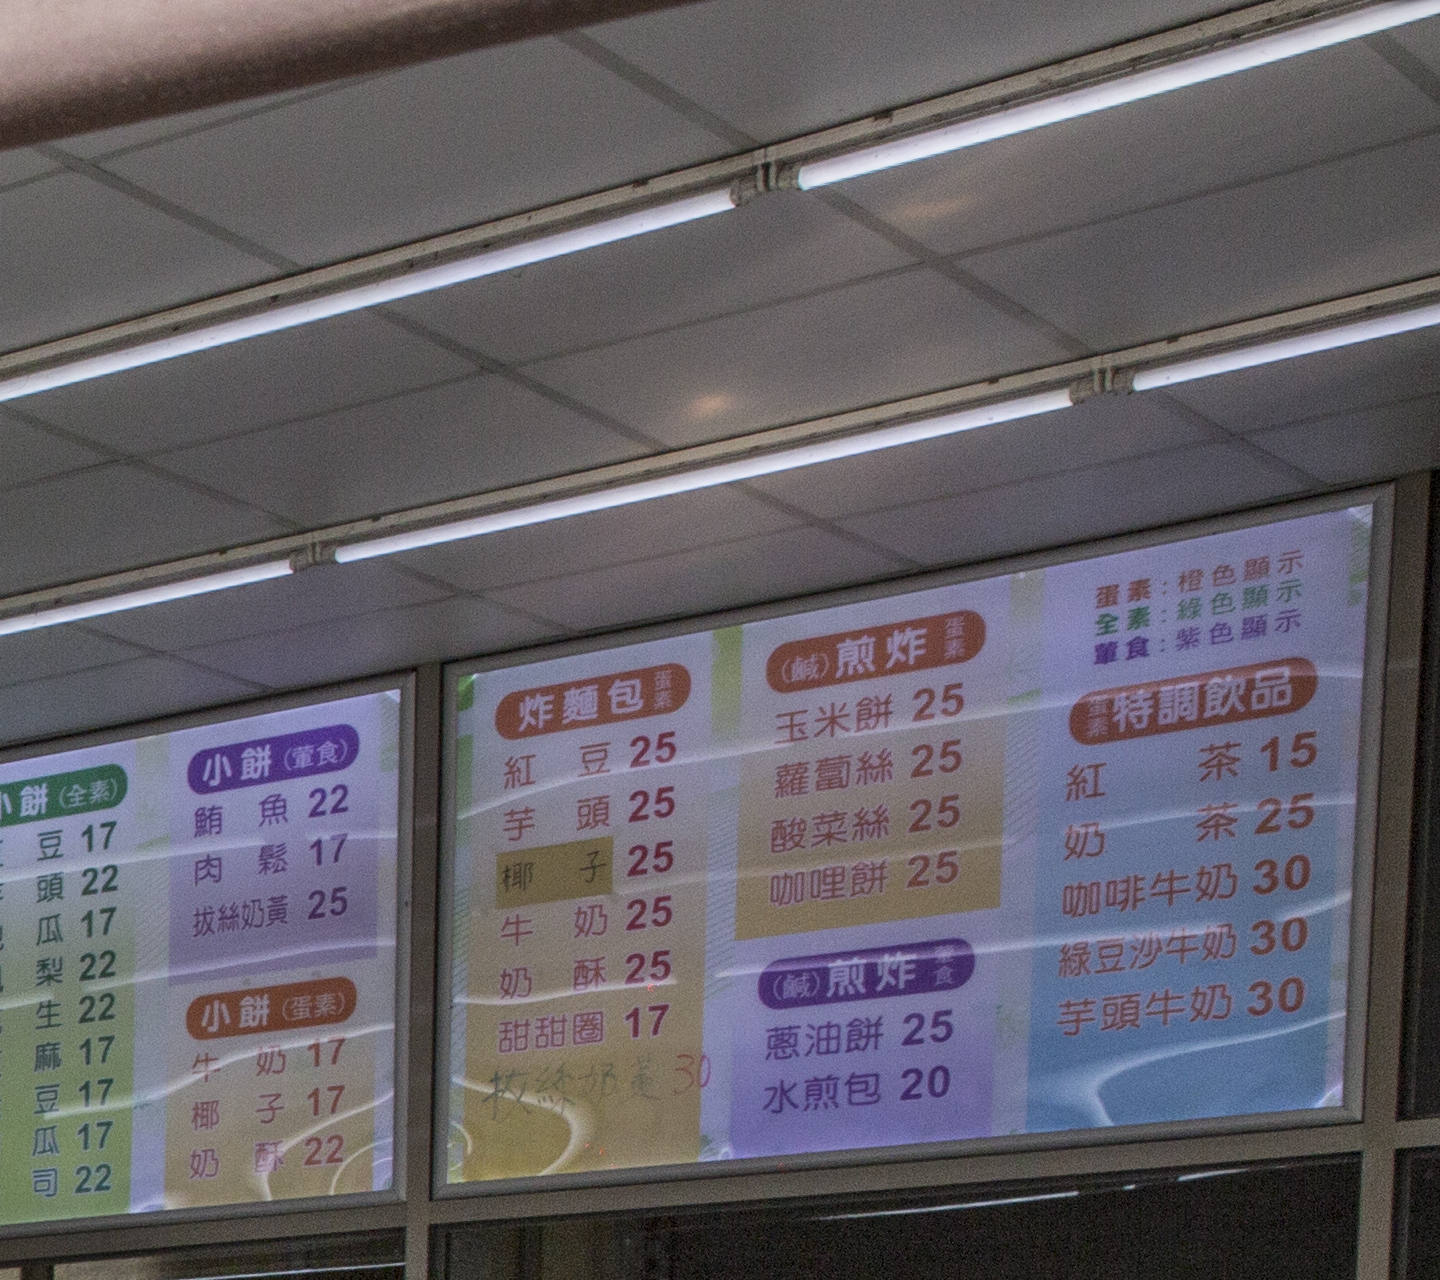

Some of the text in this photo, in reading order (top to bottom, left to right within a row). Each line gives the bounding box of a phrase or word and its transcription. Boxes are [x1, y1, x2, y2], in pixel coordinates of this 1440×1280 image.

[518, 674, 645, 732] 炸麵包
[775, 683, 964, 747] 玉米餅 25
[1114, 664, 1291, 732] 特調飲品
[504, 732, 678, 788] 紅豆 25
[773, 740, 961, 799] 蘿蔔絲 25
[1065, 730, 1318, 802] 紅茶 15
[194, 785, 349, 837] 鮪魚 22
[504, 786, 676, 841] 芋頭 25
[768, 796, 960, 855] 酸菜絲 25
[1064, 792, 1315, 860] 奶茶 25
[80, 822, 115, 852] 17
[194, 834, 345, 885] 肉鬆 17
[626, 842, 675, 880] 25
[80, 865, 119, 896] 22
[769, 851, 959, 907] 咖哩餅 25
[1062, 853, 1311, 918] 咖啡牛奶 30
[80, 908, 115, 938] 17
[192, 887, 348, 938] 拔絲奶黃 25
[501, 896, 673, 946] 牛奶 25
[79, 951, 117, 981] 22
[623, 950, 672, 986] 25
[1059, 916, 1309, 978] 綠豆沙牛奶 30
[78, 994, 116, 1024] 22
[498, 1004, 670, 1054] 甜甜圈 17
[1058, 978, 1306, 1037] 芋頭牛奶 30
[78, 1037, 114, 1067] 17
[306, 1038, 345, 1069] 17
[765, 1010, 953, 1062] 蔥油餅 25
[78, 1080, 113, 1110] 17
[672, 1053, 711, 1095] 30
[762, 1067, 951, 1114] 水煎包 20
[191, 1086, 344, 1131] 椰子 17
[76, 1121, 114, 1152] 17
[304, 1135, 344, 1166] 22
[74, 1164, 111, 1194] 22
